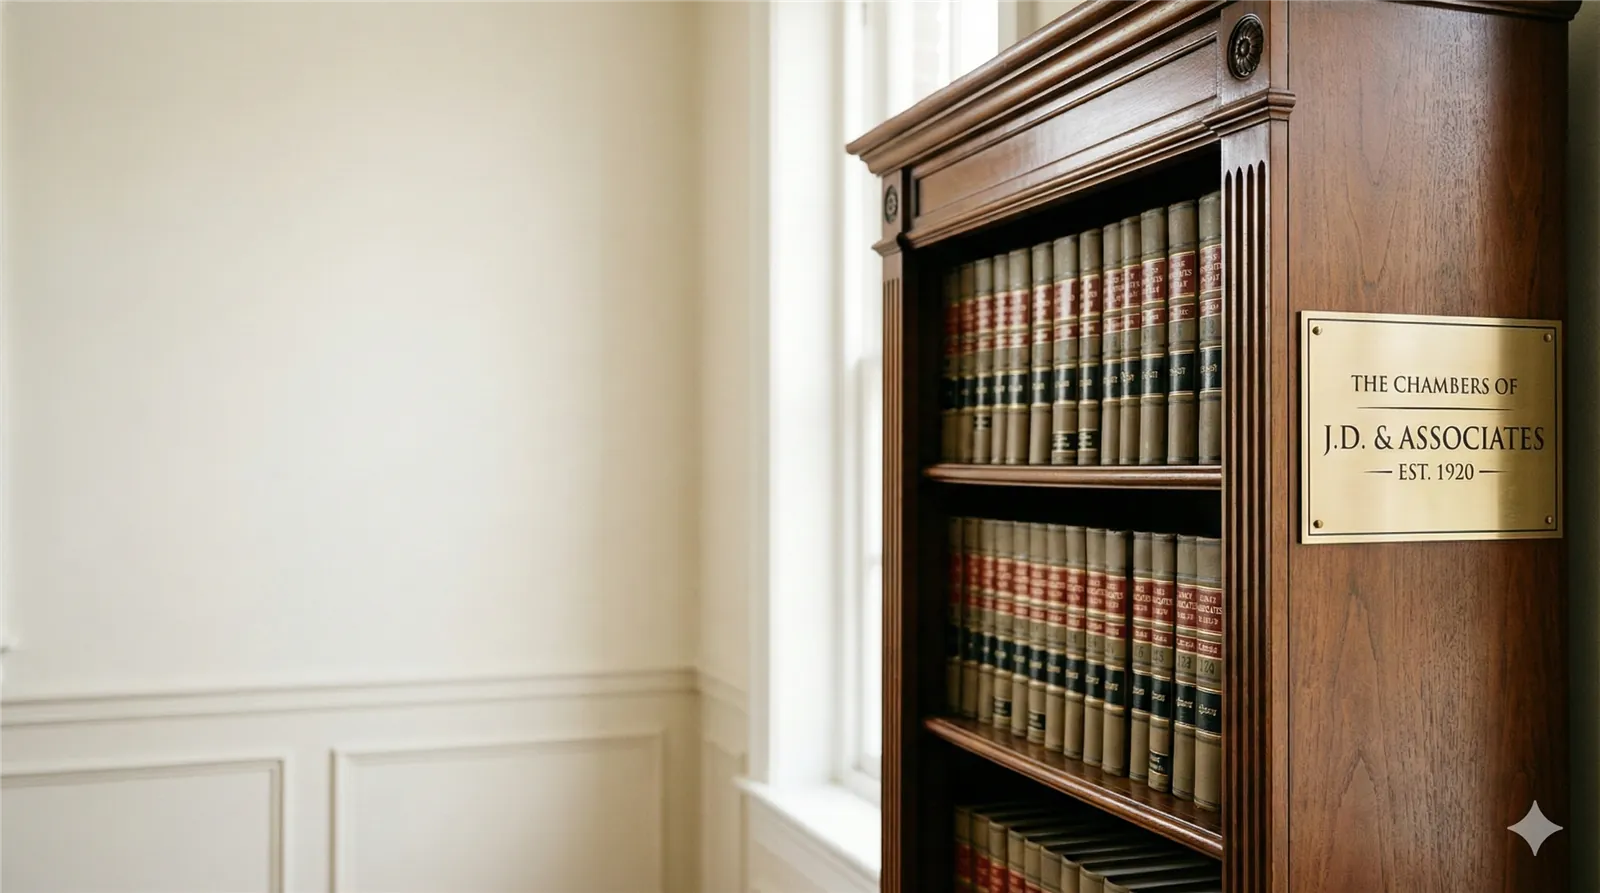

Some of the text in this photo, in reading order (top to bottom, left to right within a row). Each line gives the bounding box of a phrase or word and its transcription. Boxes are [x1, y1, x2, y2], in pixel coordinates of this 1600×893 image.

[1351, 375, 1517, 395] THE CHAMBERS OF
[1324, 425, 1543, 456] J.D. & ASSOCIATES
[1399, 463, 1474, 480] EST. 1920
